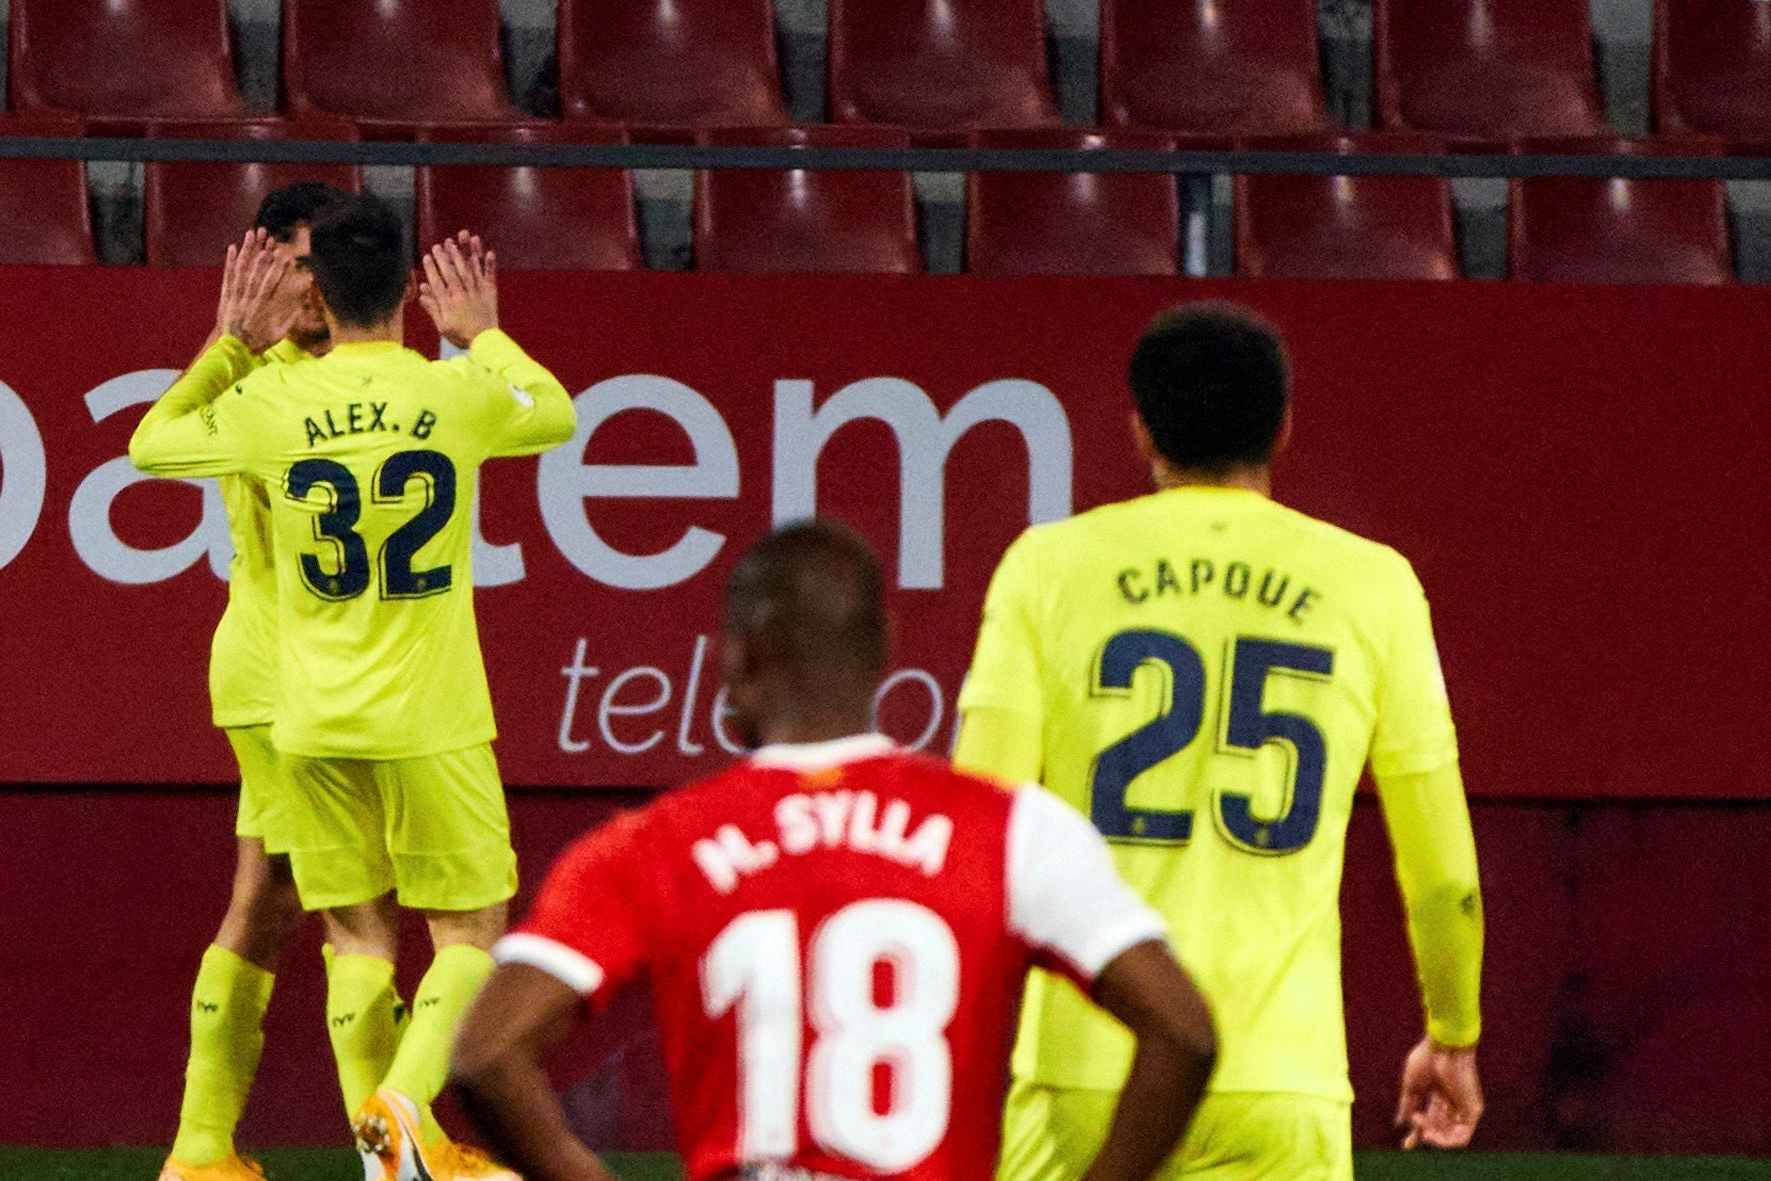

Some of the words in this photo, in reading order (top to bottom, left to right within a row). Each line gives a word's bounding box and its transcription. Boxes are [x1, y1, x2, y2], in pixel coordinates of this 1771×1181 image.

[304, 402, 400, 448] ALEX.
[411, 407, 438, 441] B
[284, 449, 458, 602] 32
[1116, 558, 1322, 626] CAPOUE
[1086, 625, 1334, 858] 25
[701, 898, 962, 1175] 18
